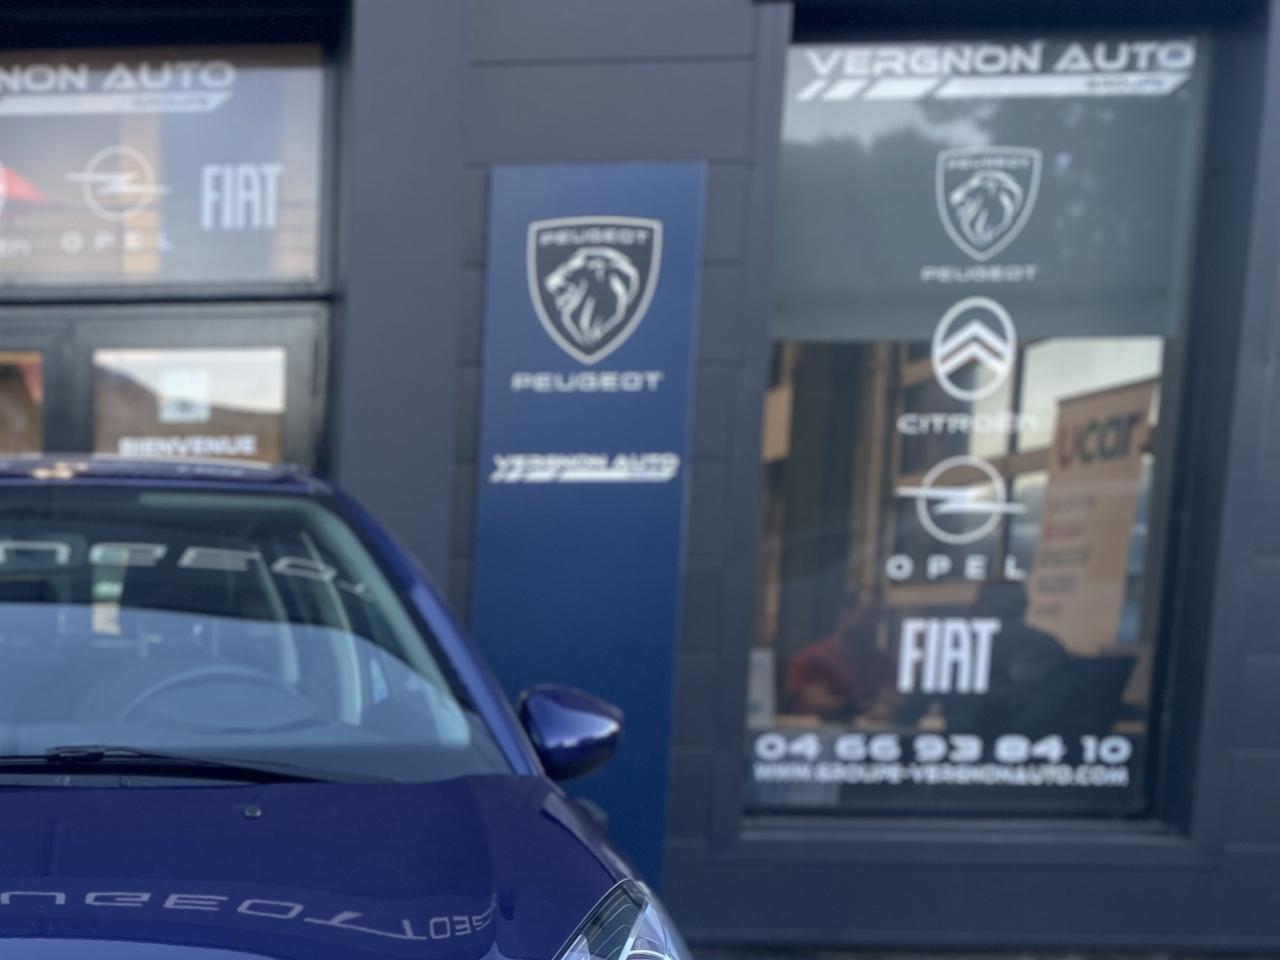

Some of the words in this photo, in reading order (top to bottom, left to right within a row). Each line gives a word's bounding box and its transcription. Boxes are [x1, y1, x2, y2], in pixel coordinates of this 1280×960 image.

[807, 45, 1045, 76] VERGNON
[1055, 40, 1197, 71] AUTO
[102, 61, 236, 90] AUTO
[201, 164, 284, 230] FIAT
[61, 230, 174, 252] OPEL
[539, 228, 649, 246] PEUGEOT
[920, 264, 1040, 283] PEUGEOT
[511, 370, 664, 392] PEUGEOT
[886, 555, 1027, 580] OPEL
[897, 619, 1000, 693] FIAT
[754, 733, 822, 762] 04
[834, 735, 902, 762] 66
[1080, 735, 1133, 764] 10
